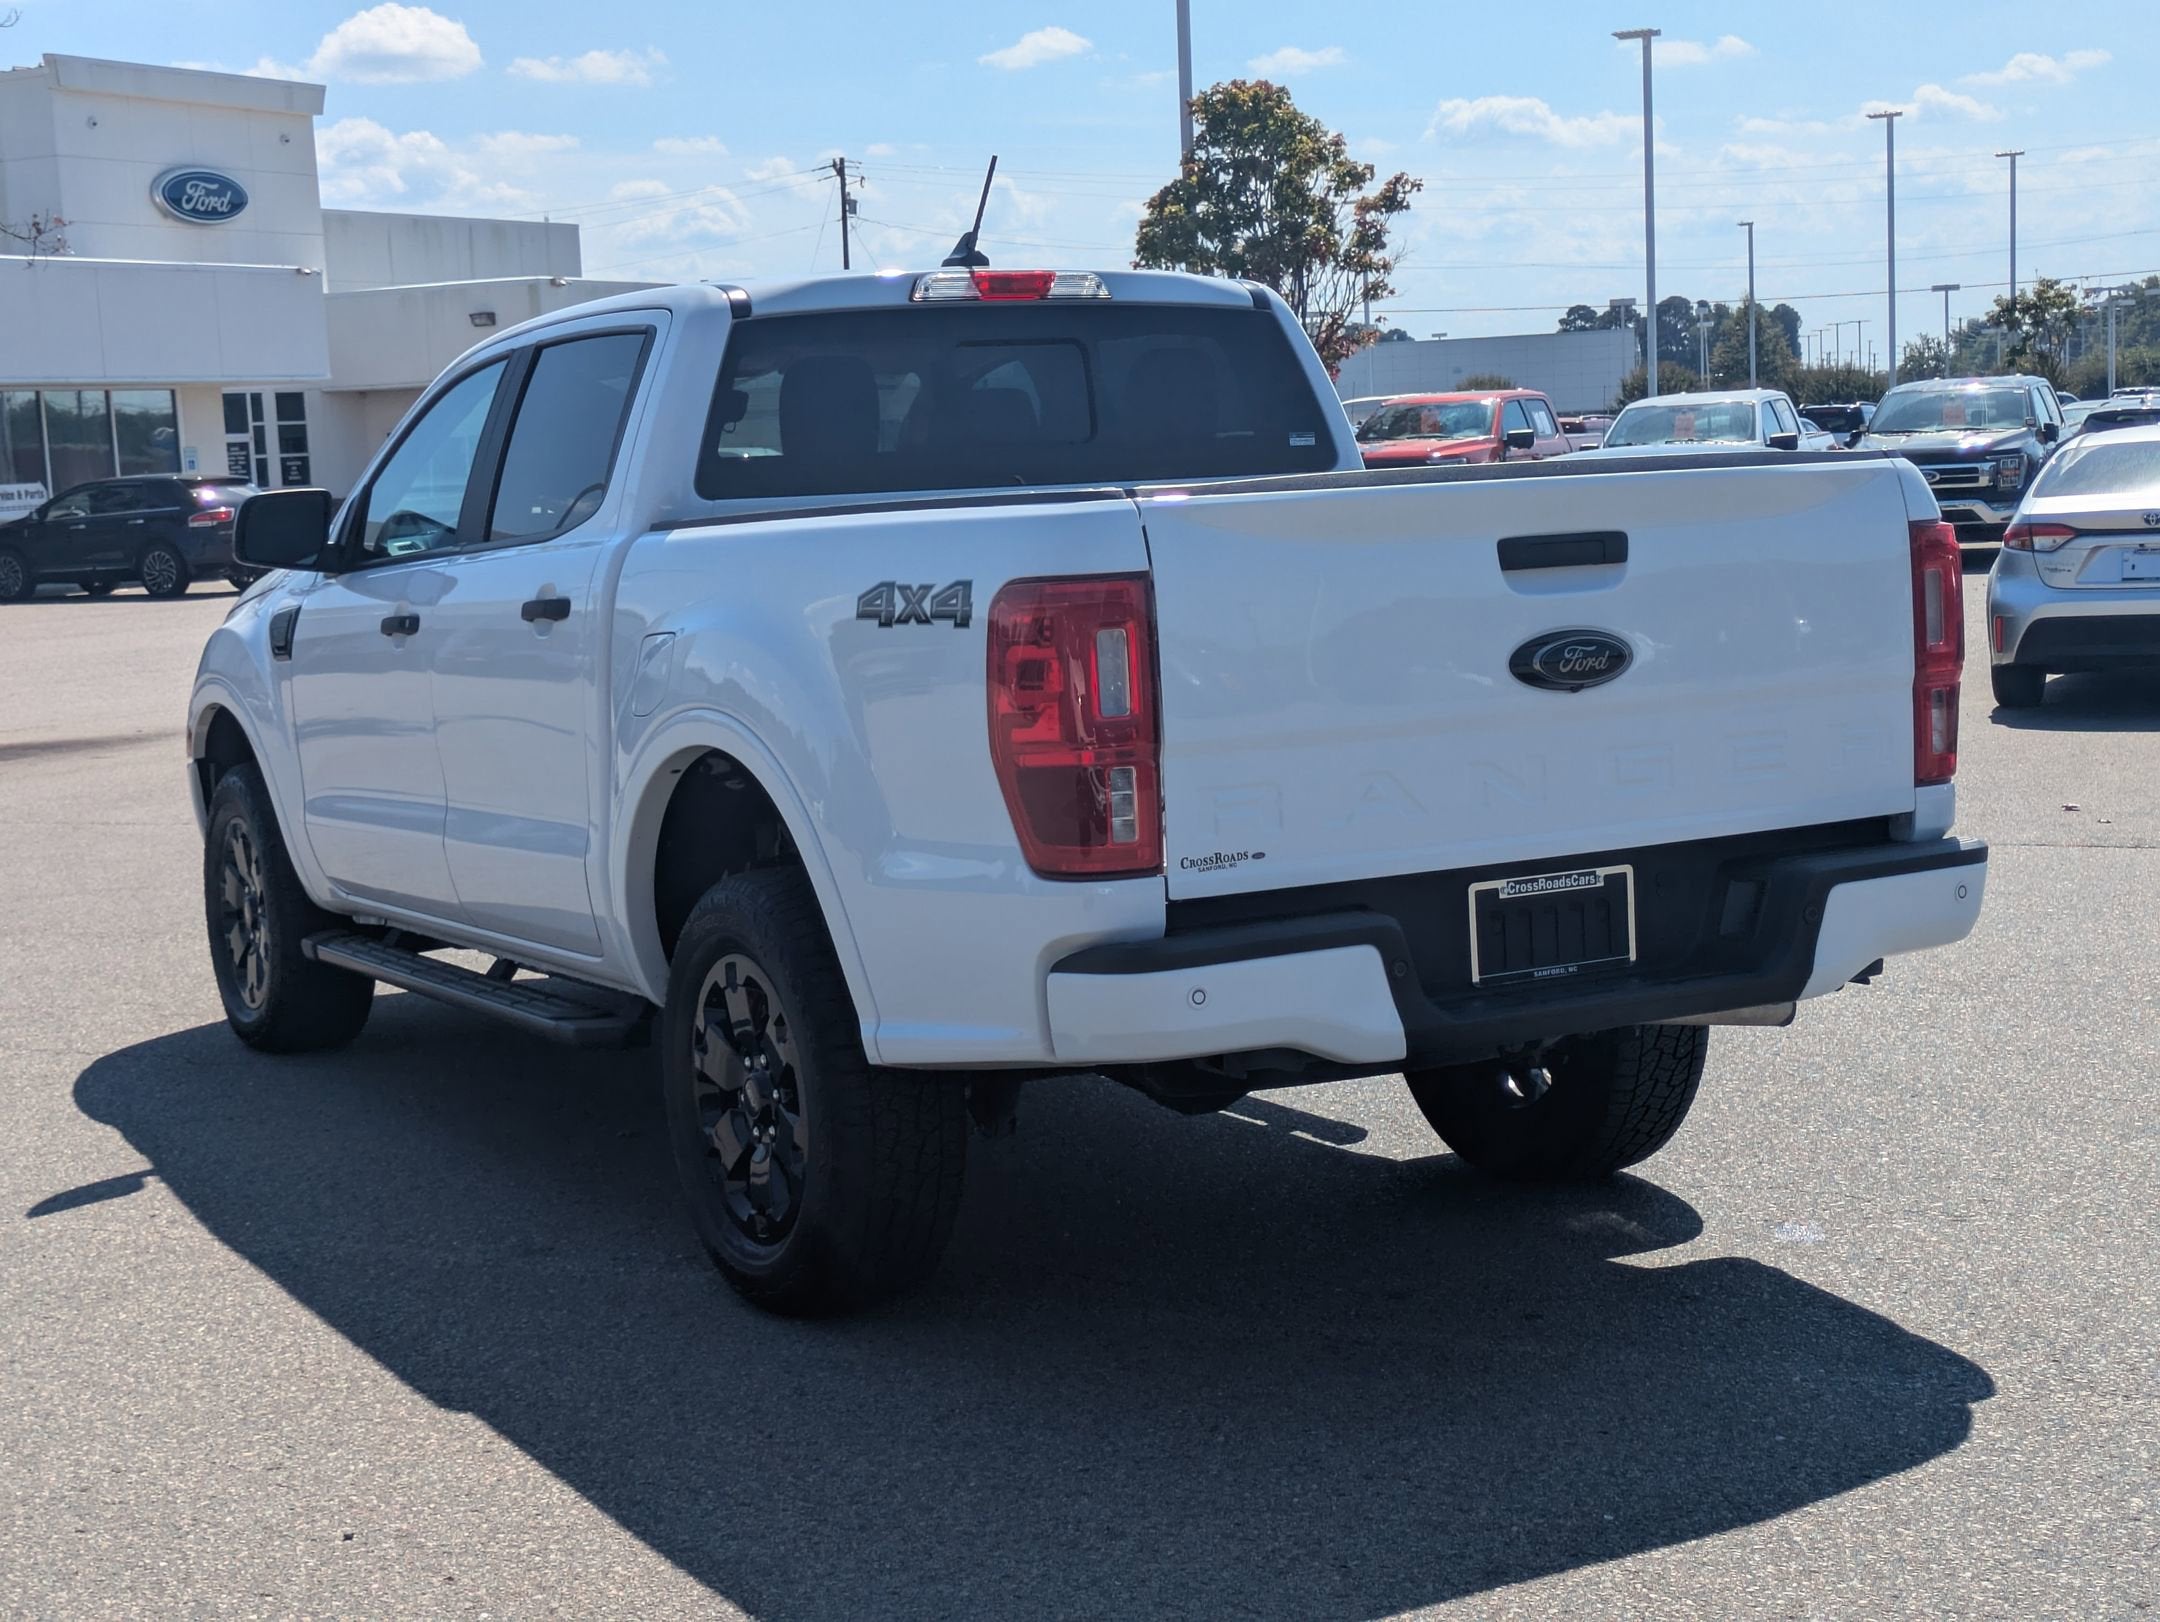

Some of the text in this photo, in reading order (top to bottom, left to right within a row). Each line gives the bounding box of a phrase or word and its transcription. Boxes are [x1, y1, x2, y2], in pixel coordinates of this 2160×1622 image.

[181, 180, 232, 213] Ford
[1560, 645, 1610, 673] Ford
[1194, 722, 1892, 836] RANGER
[1508, 874, 1596, 895] CrossRoadsCars
